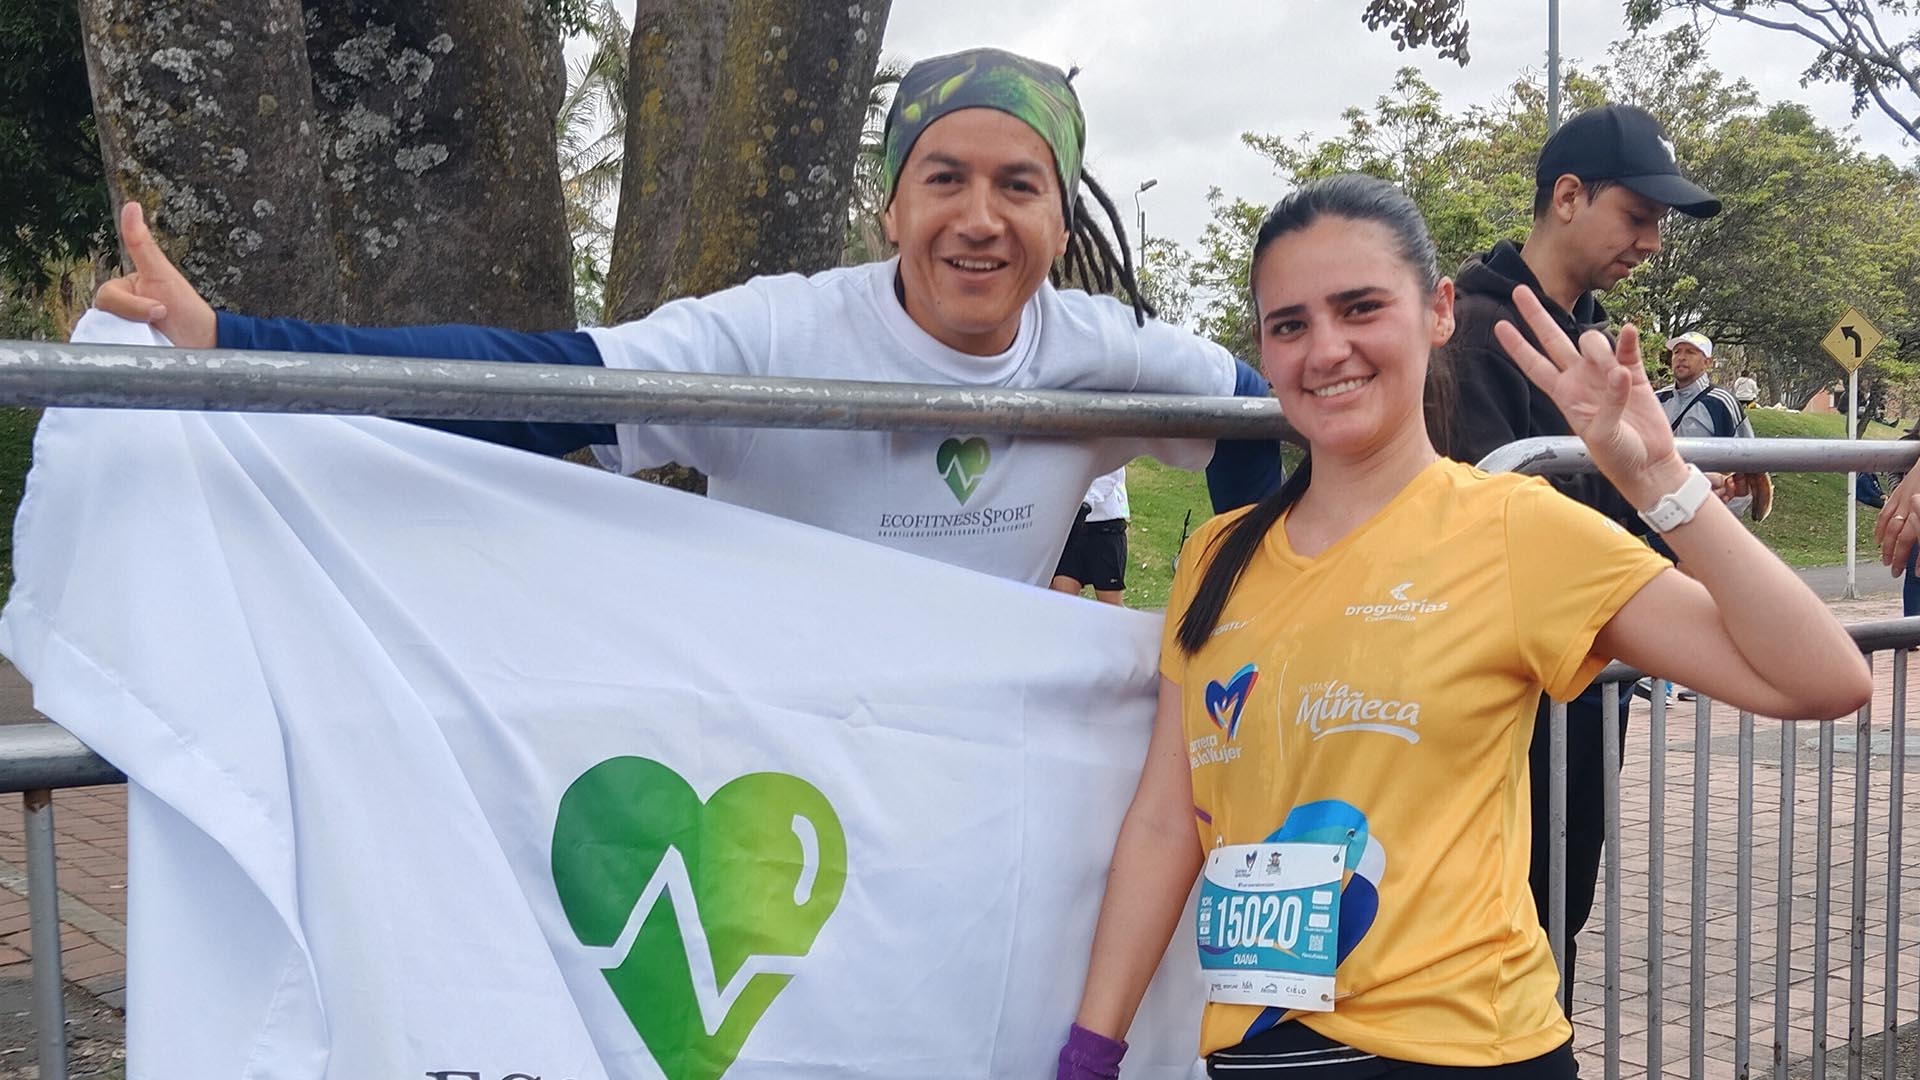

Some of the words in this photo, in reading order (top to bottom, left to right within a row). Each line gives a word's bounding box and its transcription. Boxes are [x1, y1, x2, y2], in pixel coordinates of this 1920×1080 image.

[1325, 679, 1349, 698] La
[1295, 691, 1420, 734] Muñeca
[1217, 894, 1302, 950] 15020
[1233, 953, 1258, 965] DIANA
